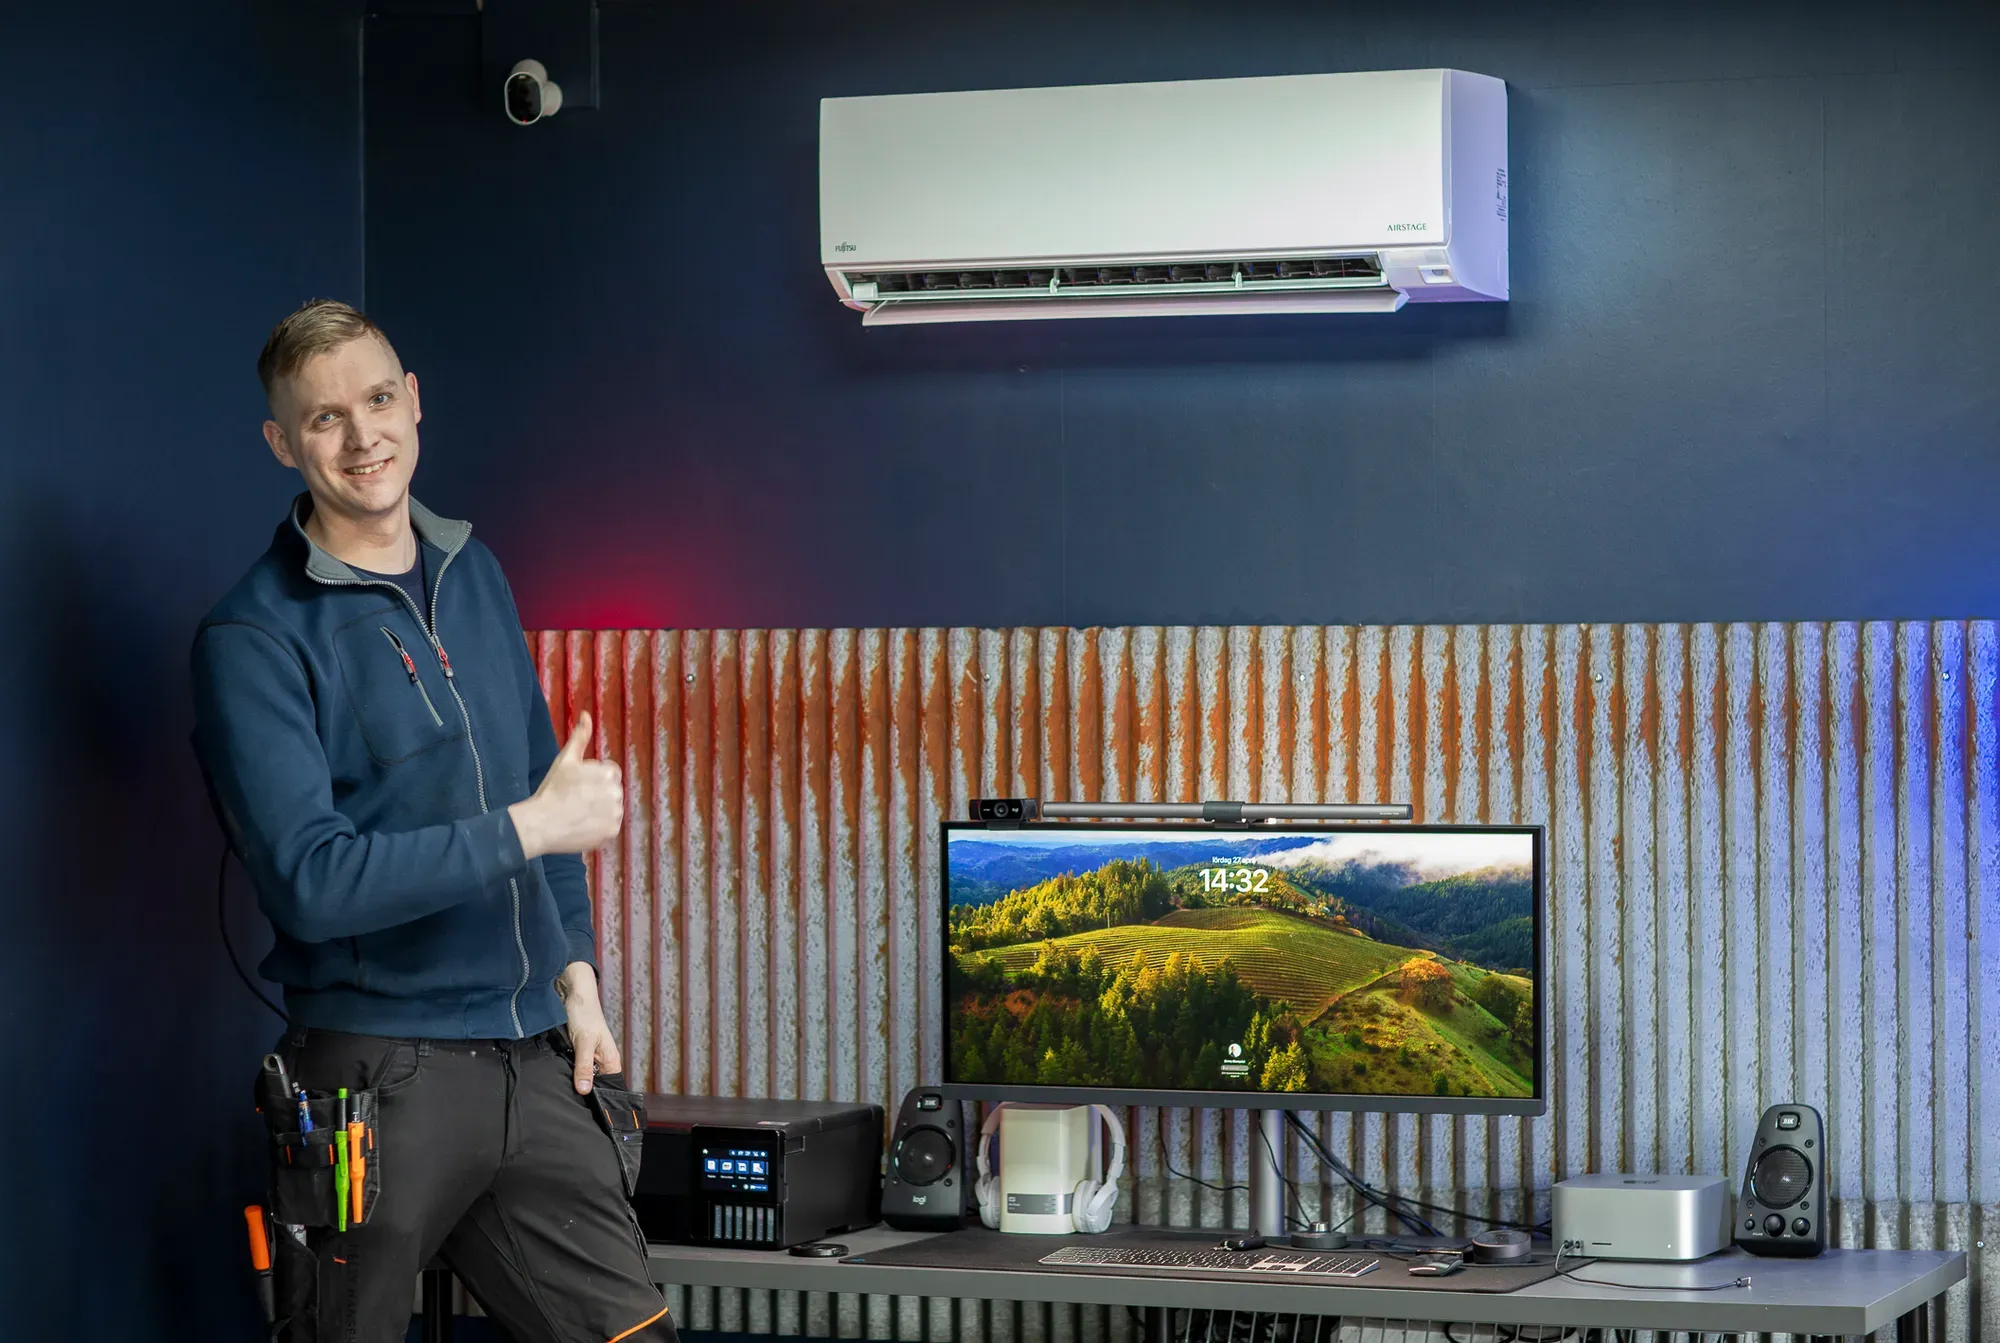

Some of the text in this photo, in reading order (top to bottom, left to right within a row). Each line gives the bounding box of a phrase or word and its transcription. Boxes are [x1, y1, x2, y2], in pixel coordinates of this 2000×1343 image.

[1387, 223, 1428, 231] AIRSTAGE
[1232, 856, 1241, 864] 27
[1199, 868, 1269, 893] 14:32
[912, 1195, 927, 1205] logi
